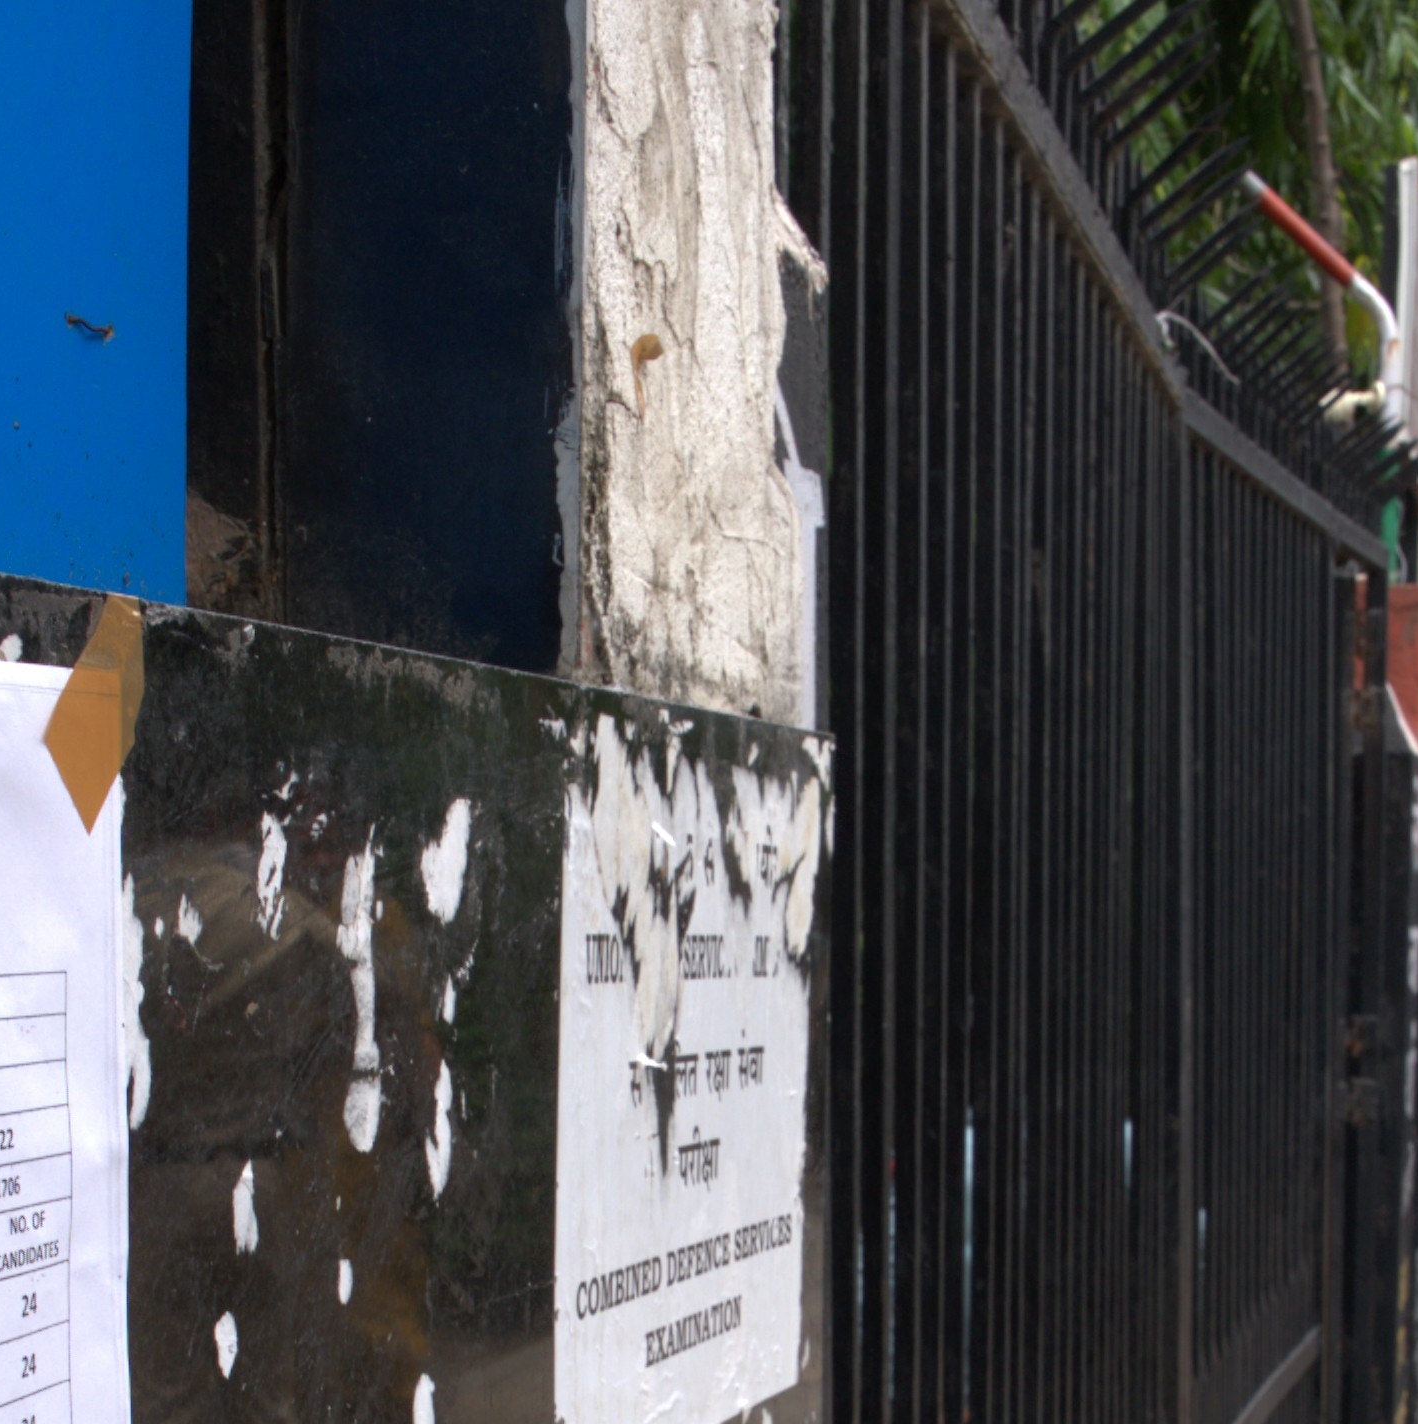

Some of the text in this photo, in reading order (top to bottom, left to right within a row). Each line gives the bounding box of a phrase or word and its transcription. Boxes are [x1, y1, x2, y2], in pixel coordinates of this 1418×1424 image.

[705, 1050, 731, 1101] रक्षा
[678, 1125, 721, 1191] परीक्षा
[9, 1210, 45, 1235] NO. OF
[576, 1214, 793, 1320] COMBINED DEFENCE SERVICES
[21, 1292, 37, 1318] 24
[644, 1295, 742, 1368] EXAMINATION
